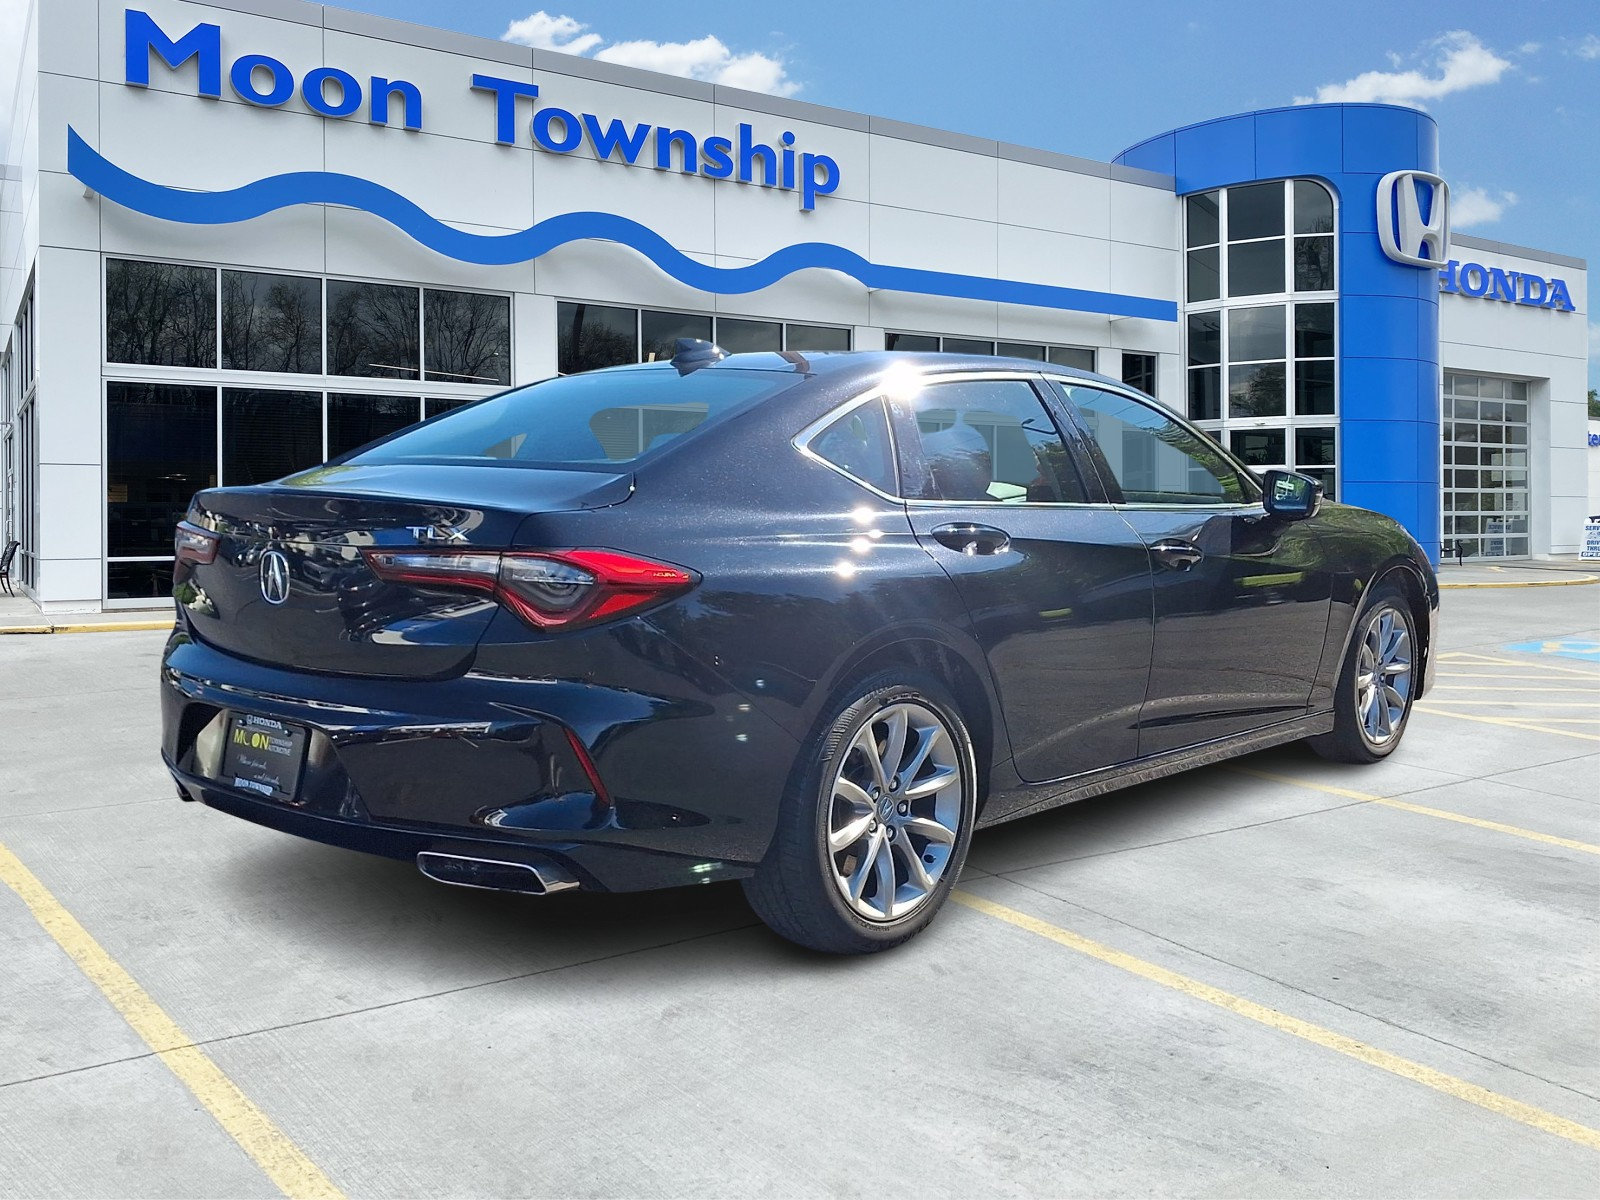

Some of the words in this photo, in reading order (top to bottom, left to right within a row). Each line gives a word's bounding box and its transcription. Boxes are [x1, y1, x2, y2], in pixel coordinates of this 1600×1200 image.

[125, 8, 422, 132] Moon
[469, 73, 840, 212] Township
[405, 525, 470, 541] TLX
[253, 716, 282, 729] HONDA
